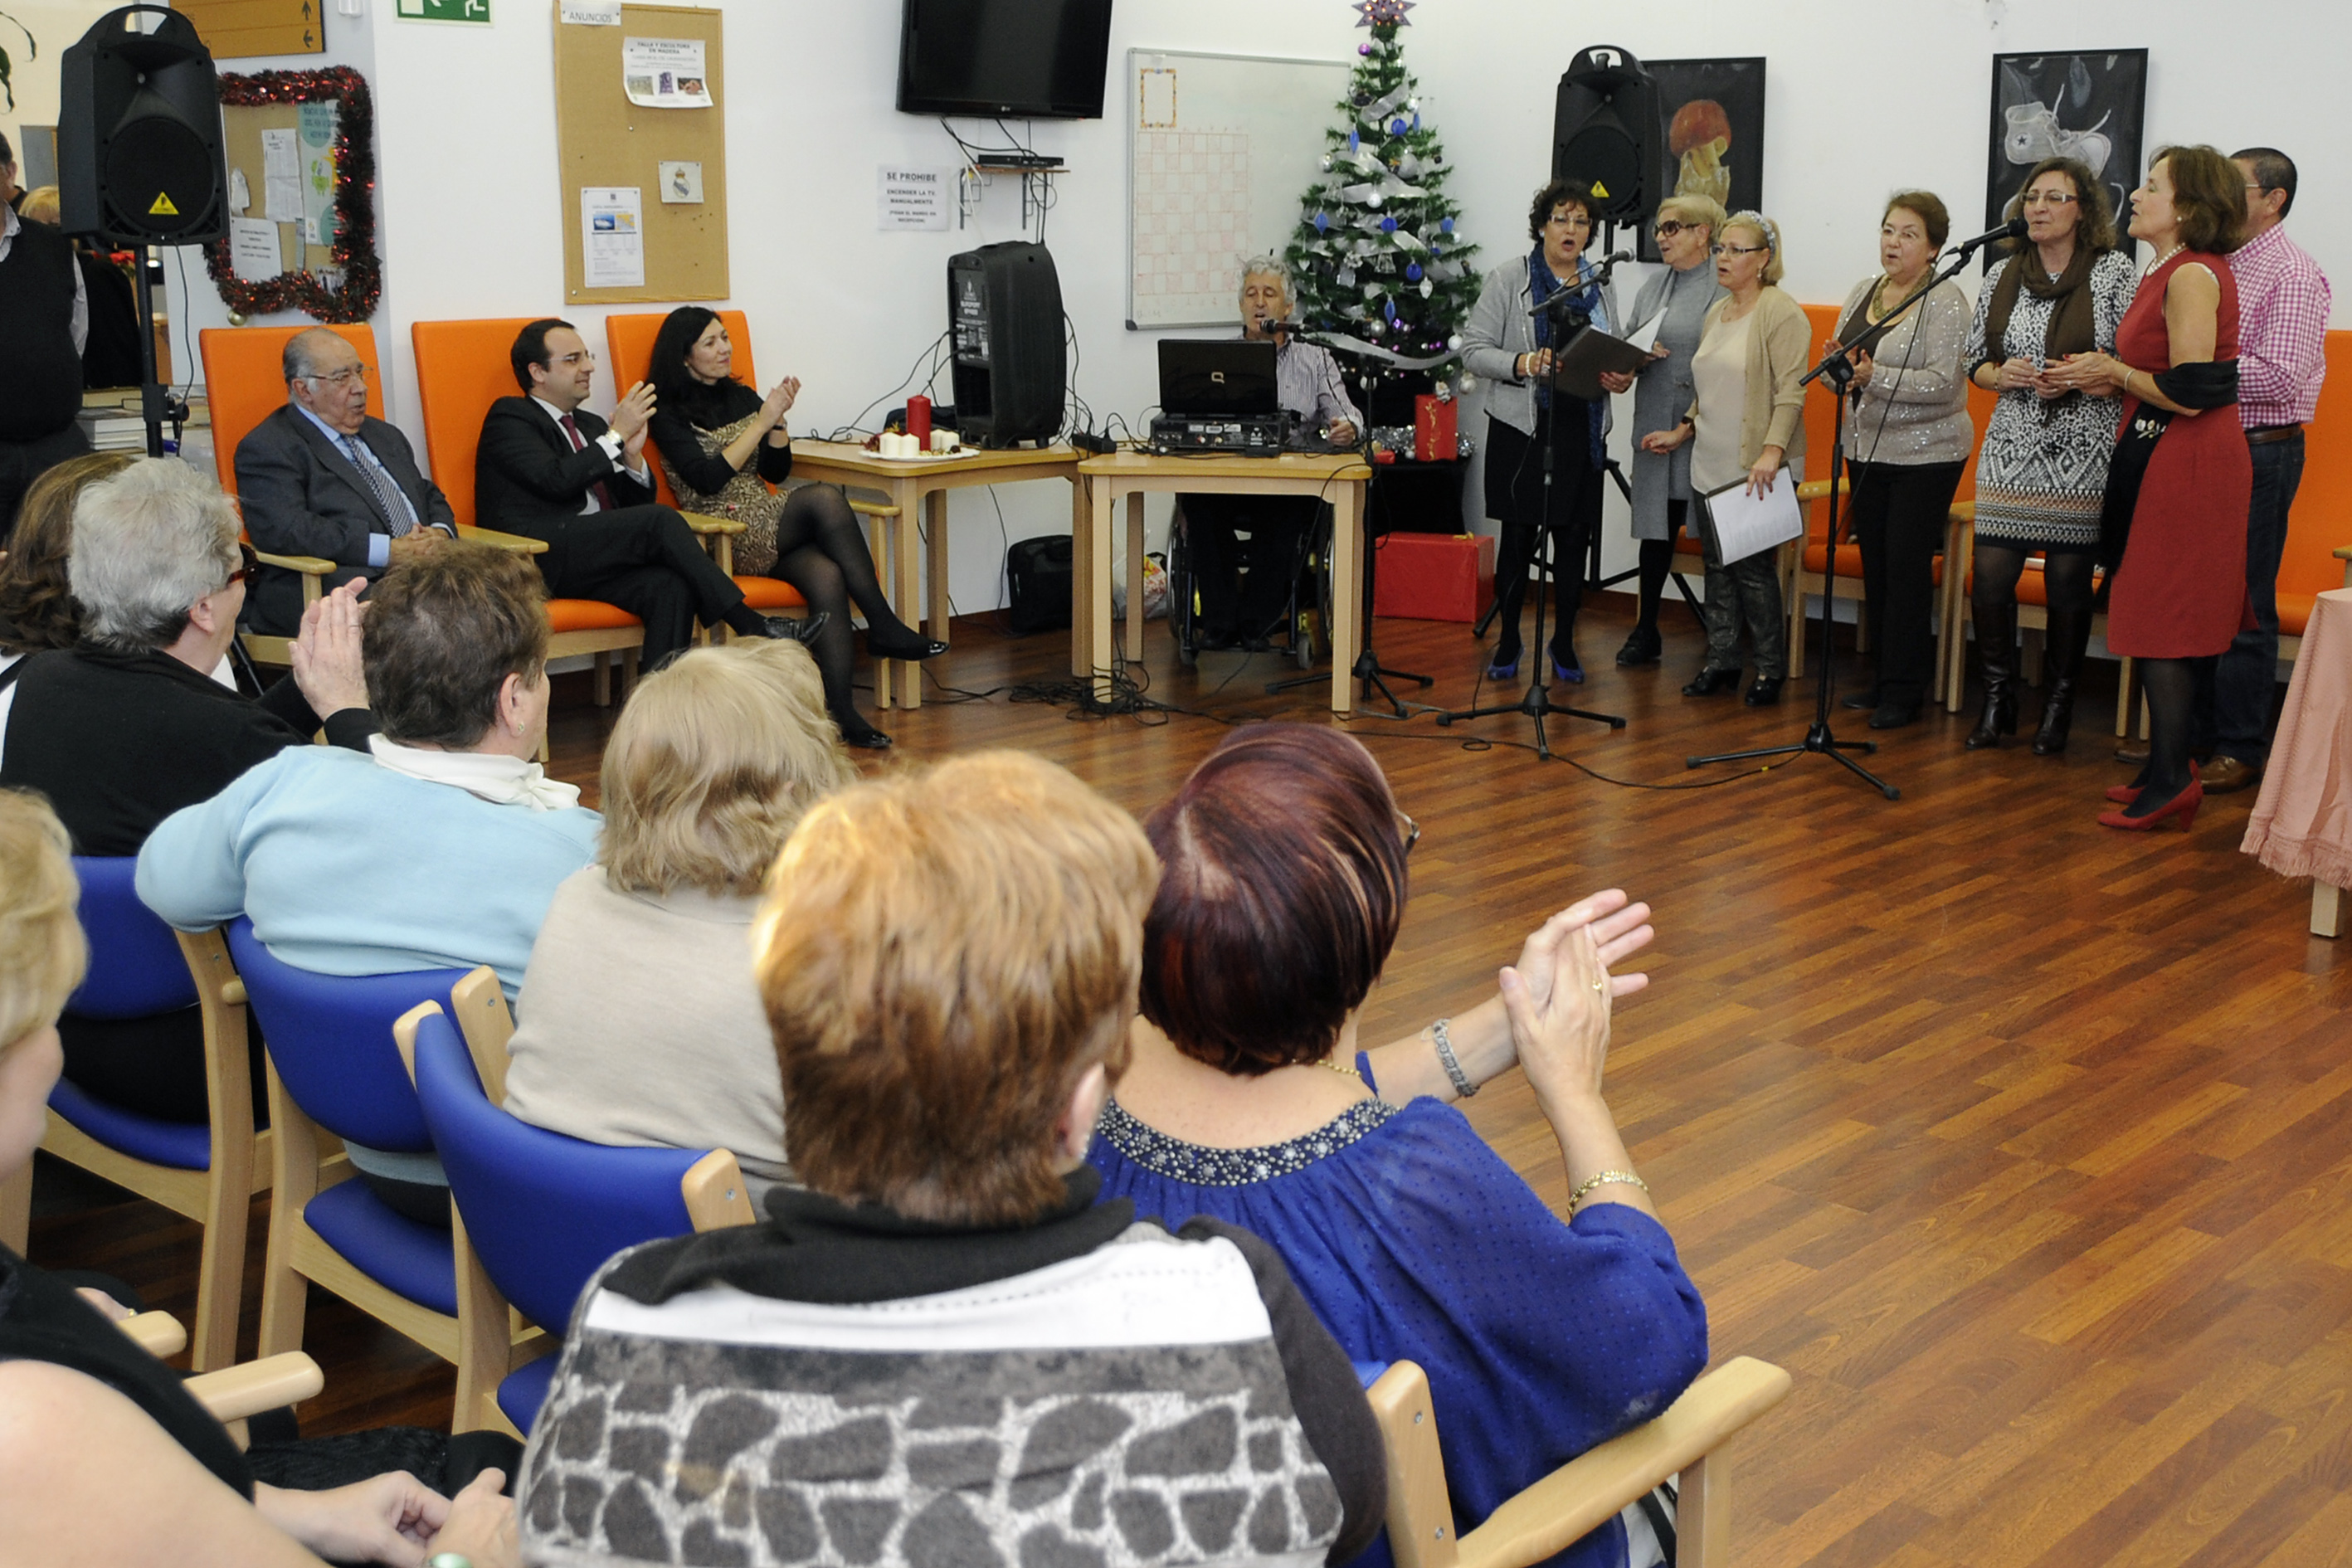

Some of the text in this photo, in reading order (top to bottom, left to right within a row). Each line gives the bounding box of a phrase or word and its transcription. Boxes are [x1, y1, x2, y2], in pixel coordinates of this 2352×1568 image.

[569, 12, 612, 22] ANUNCIOS
[887, 172, 937, 182] SE PROHIBE
